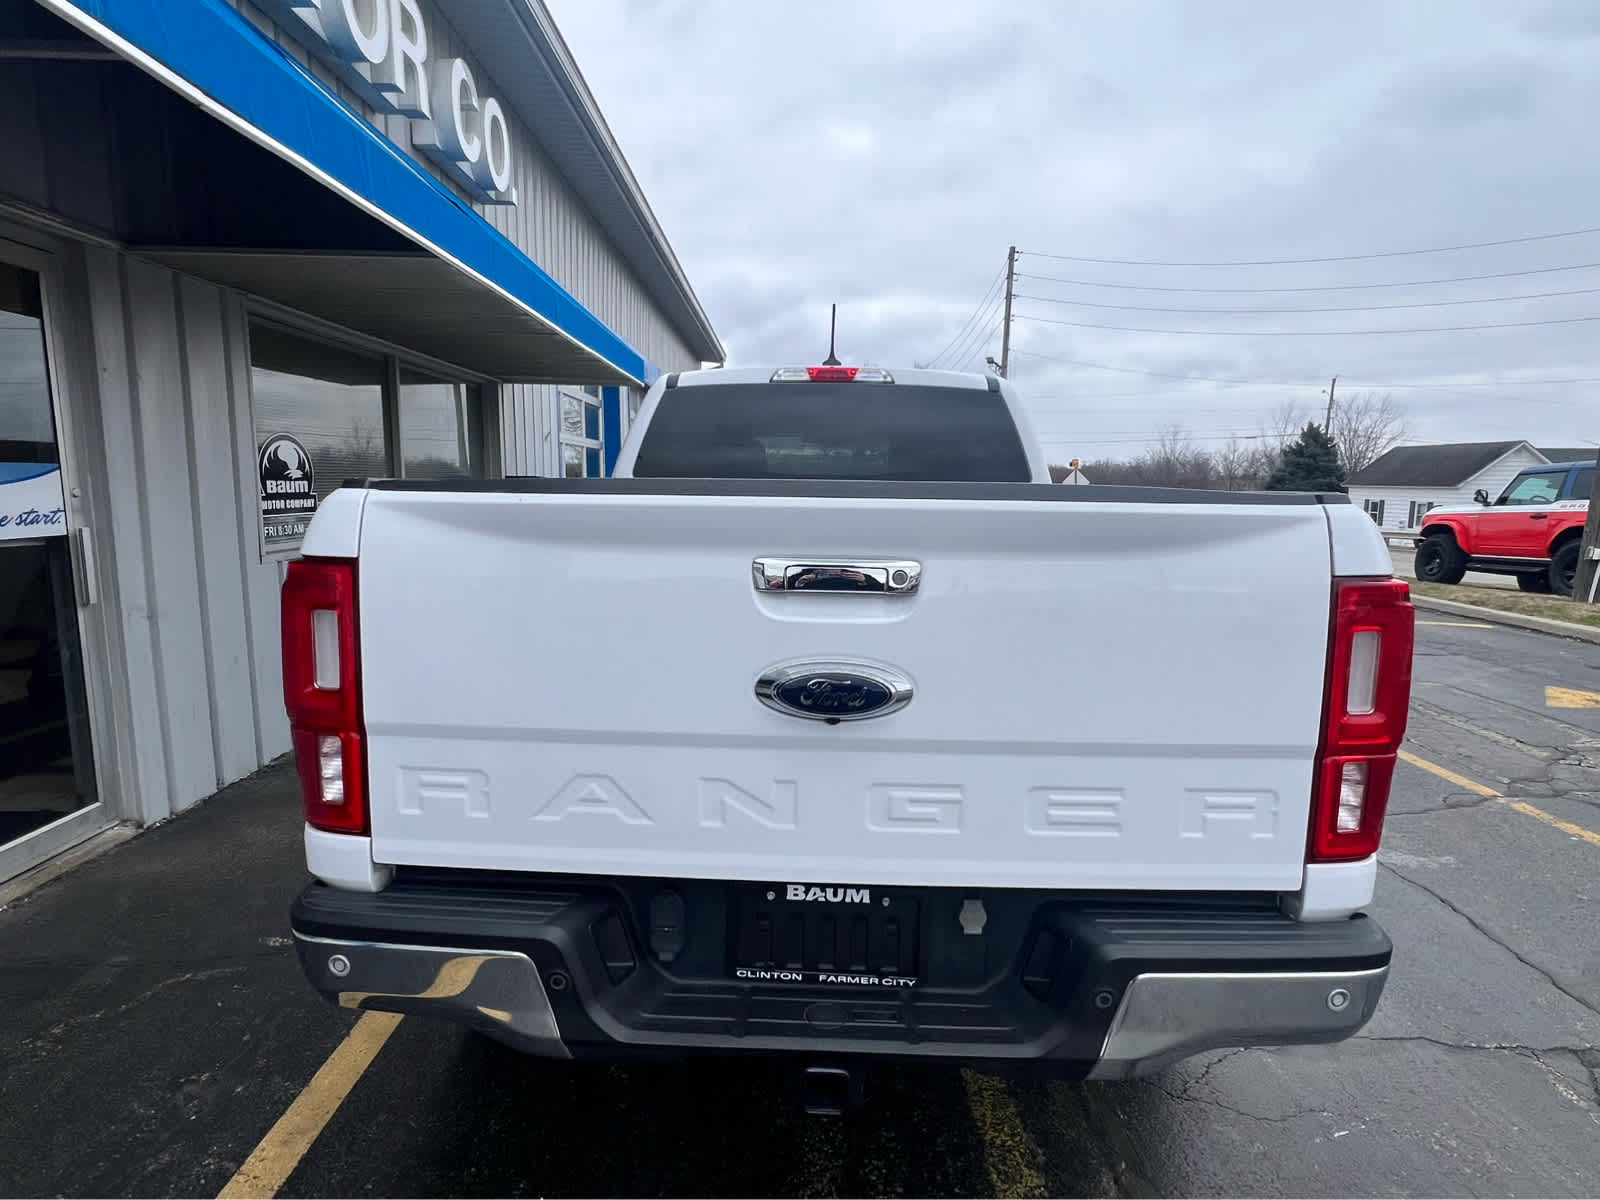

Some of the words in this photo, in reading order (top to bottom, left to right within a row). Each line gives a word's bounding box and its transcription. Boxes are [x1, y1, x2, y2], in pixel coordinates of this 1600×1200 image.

[312, 0, 431, 120] OR
[266, 479, 309, 493] Baum
[262, 500, 286, 510] MOTOR
[286, 498, 315, 508] COMPANY
[15, 508, 65, 526] start.
[264, 526, 277, 536] FRI
[293, 522, 304, 534] AM
[801, 678, 869, 707] Ford
[398, 765, 1280, 838] RANGER
[786, 884, 870, 904] BAUM
[736, 970, 802, 981] CLINTON
[819, 974, 879, 985] FARMER
[882, 978, 916, 987] CITY
